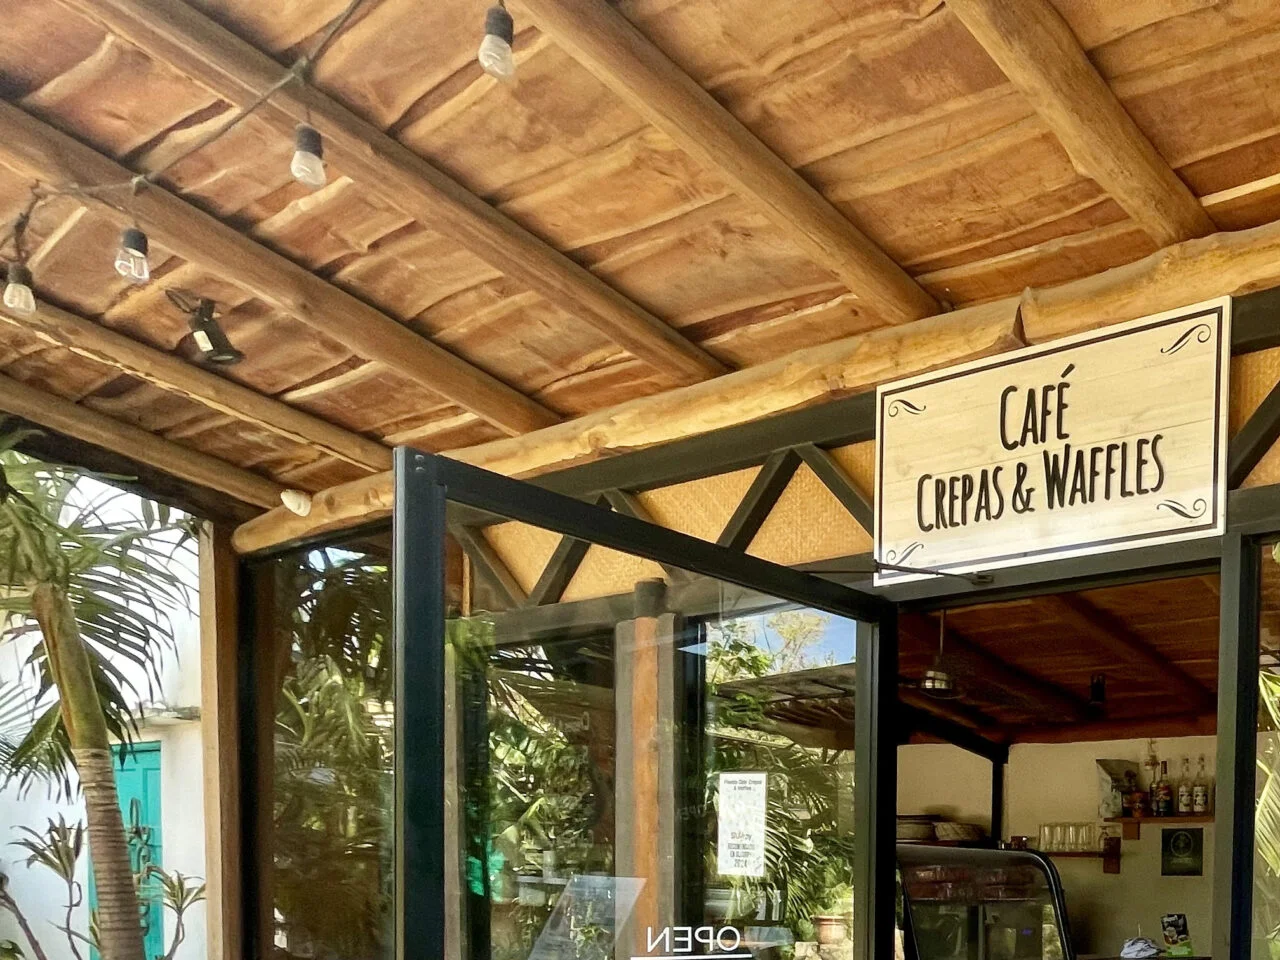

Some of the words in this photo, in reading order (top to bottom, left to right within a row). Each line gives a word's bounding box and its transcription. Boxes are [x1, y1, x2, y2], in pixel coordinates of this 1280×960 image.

[1000, 363, 1076, 451] CAFÉ
[916, 465, 1005, 533] CREPAS
[1011, 461, 1036, 515] &
[1042, 434, 1165, 510] WAFFLES
